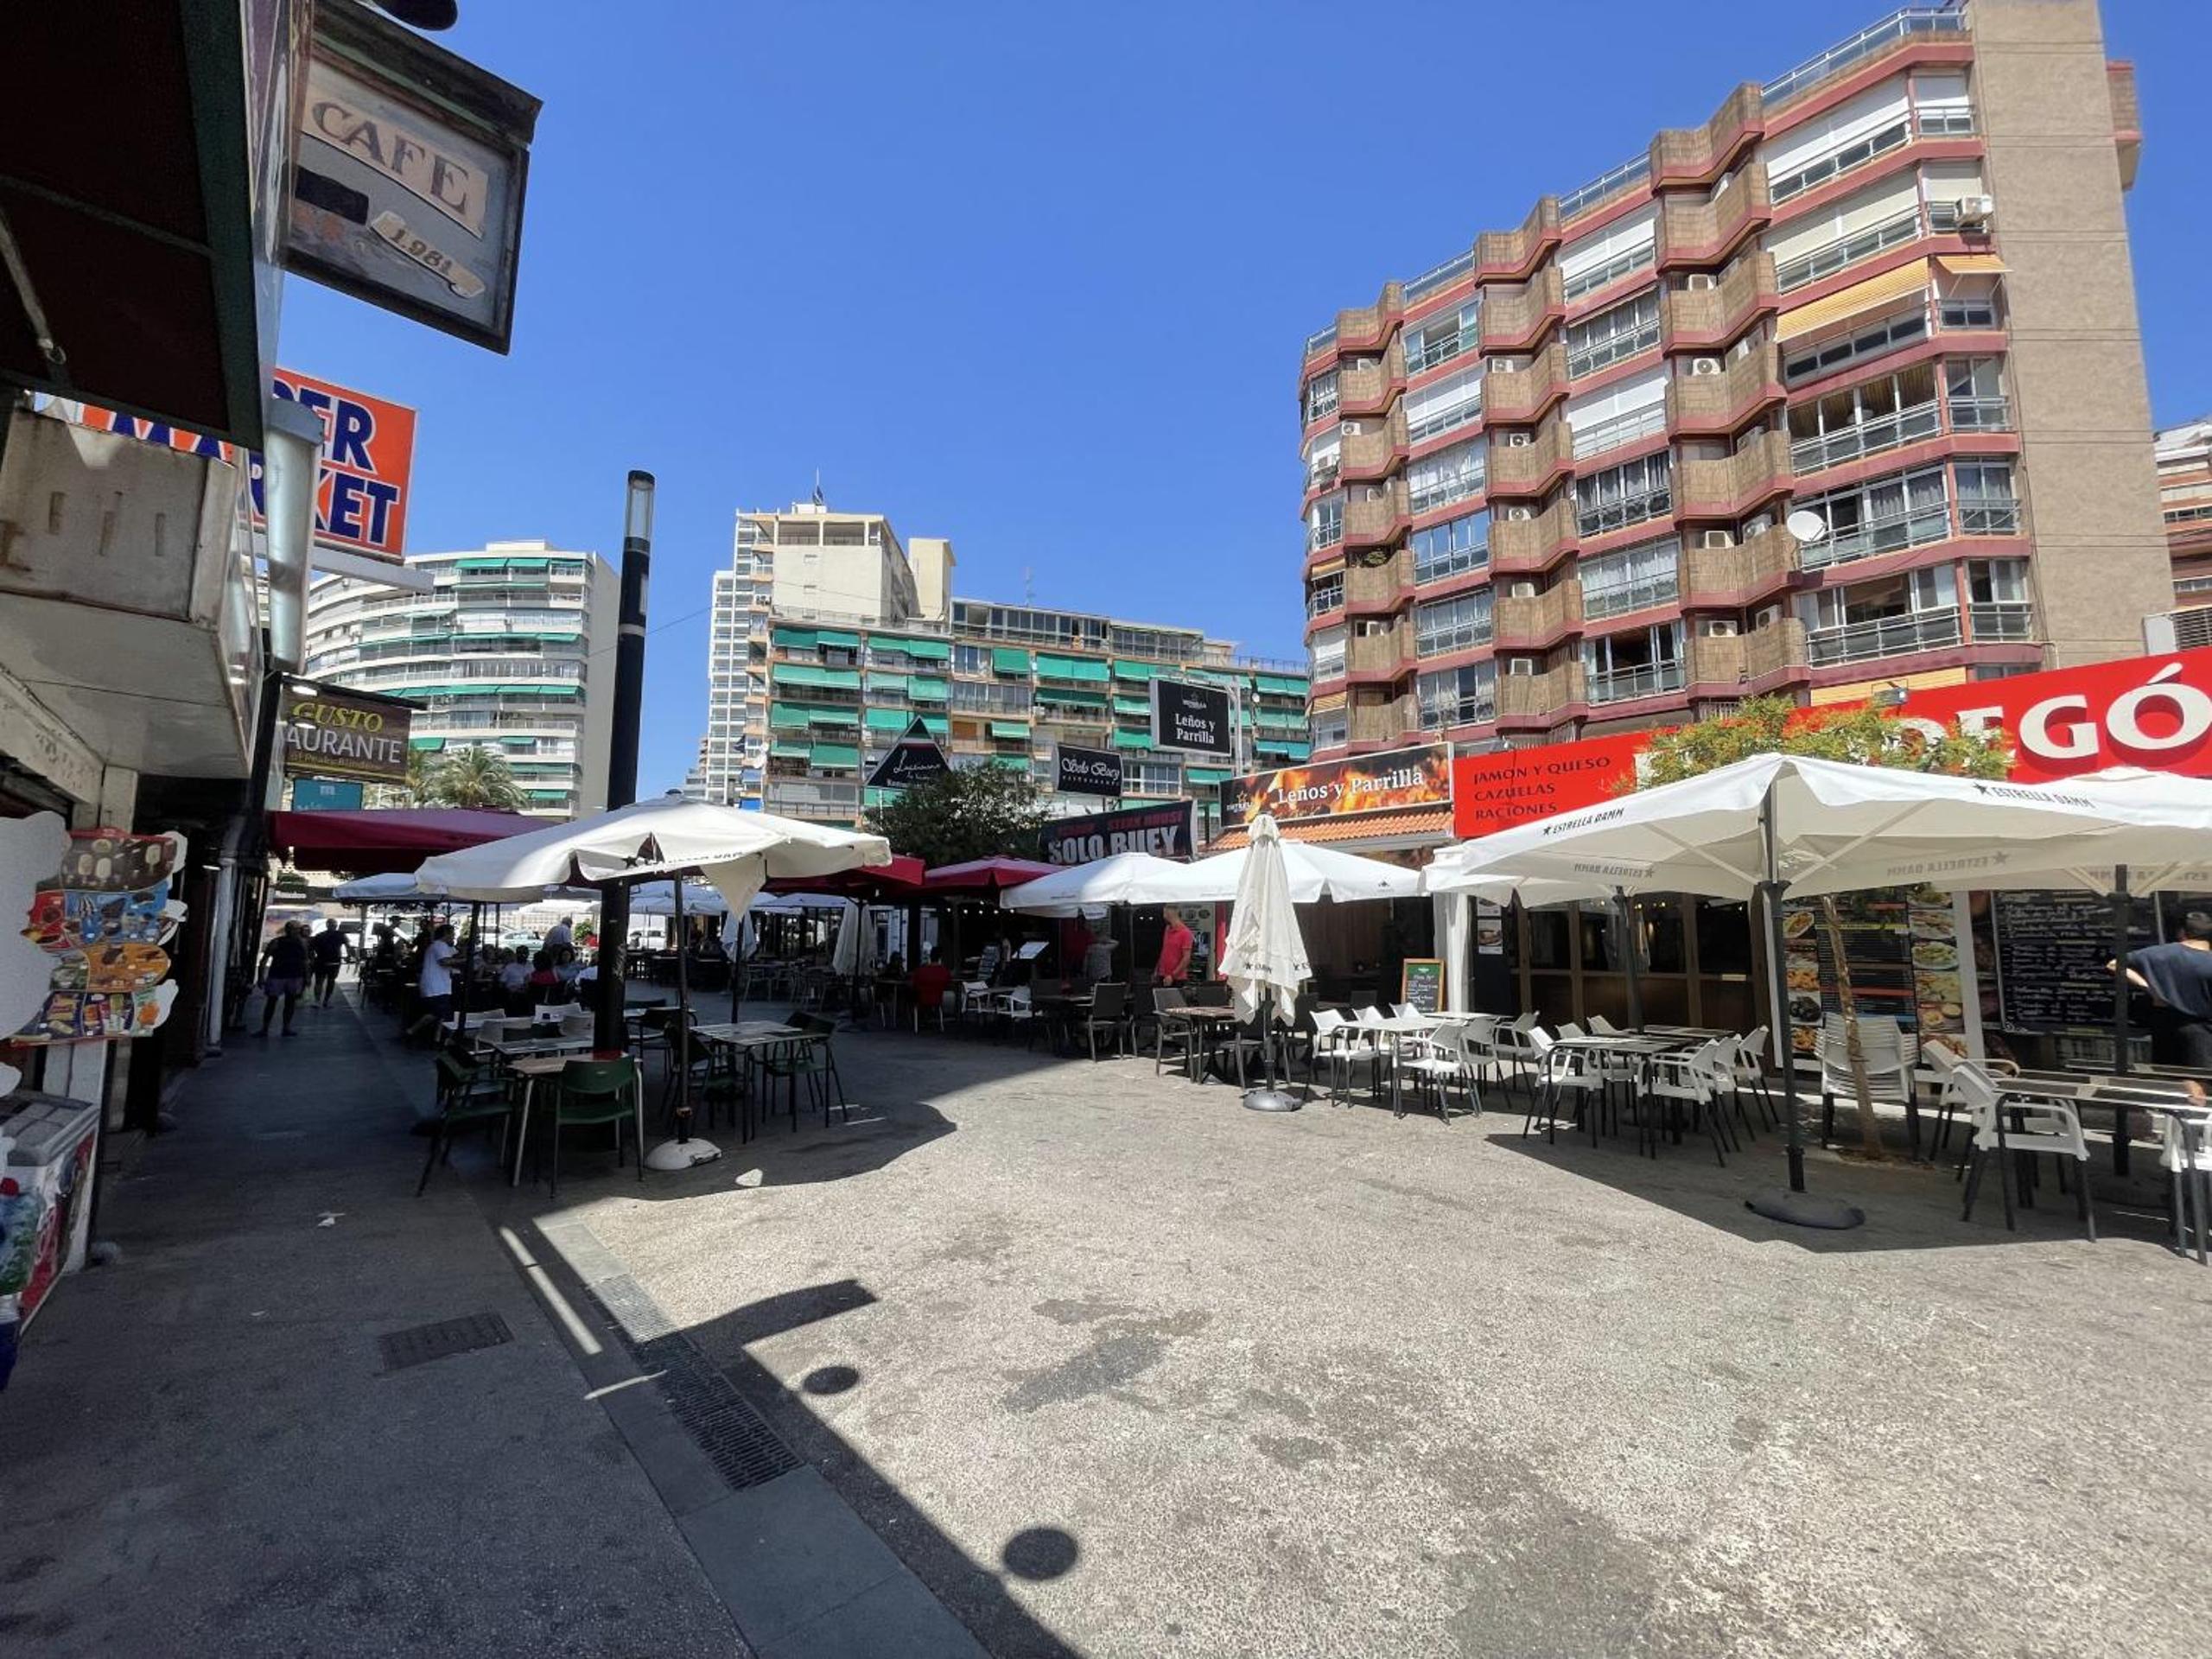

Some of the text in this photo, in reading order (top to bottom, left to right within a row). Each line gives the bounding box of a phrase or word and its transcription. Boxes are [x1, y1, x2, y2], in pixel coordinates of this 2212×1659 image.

[312, 101, 470, 215] CAFE
[1175, 714, 1216, 731] Leños y
[1177, 728, 1215, 744] Parrilla
[1535, 765, 1543, 777] Y
[1548, 757, 1611, 774] QUESO
[1278, 768, 1424, 804] Leños y Parrilla
[1474, 782, 1555, 802] CAZUELAS
[1474, 802, 1557, 820] RACIONES
[1552, 815, 1592, 835] ESTRELLA
[1048, 834, 1104, 864] SOLO
[1110, 825, 1179, 857] BUEY
